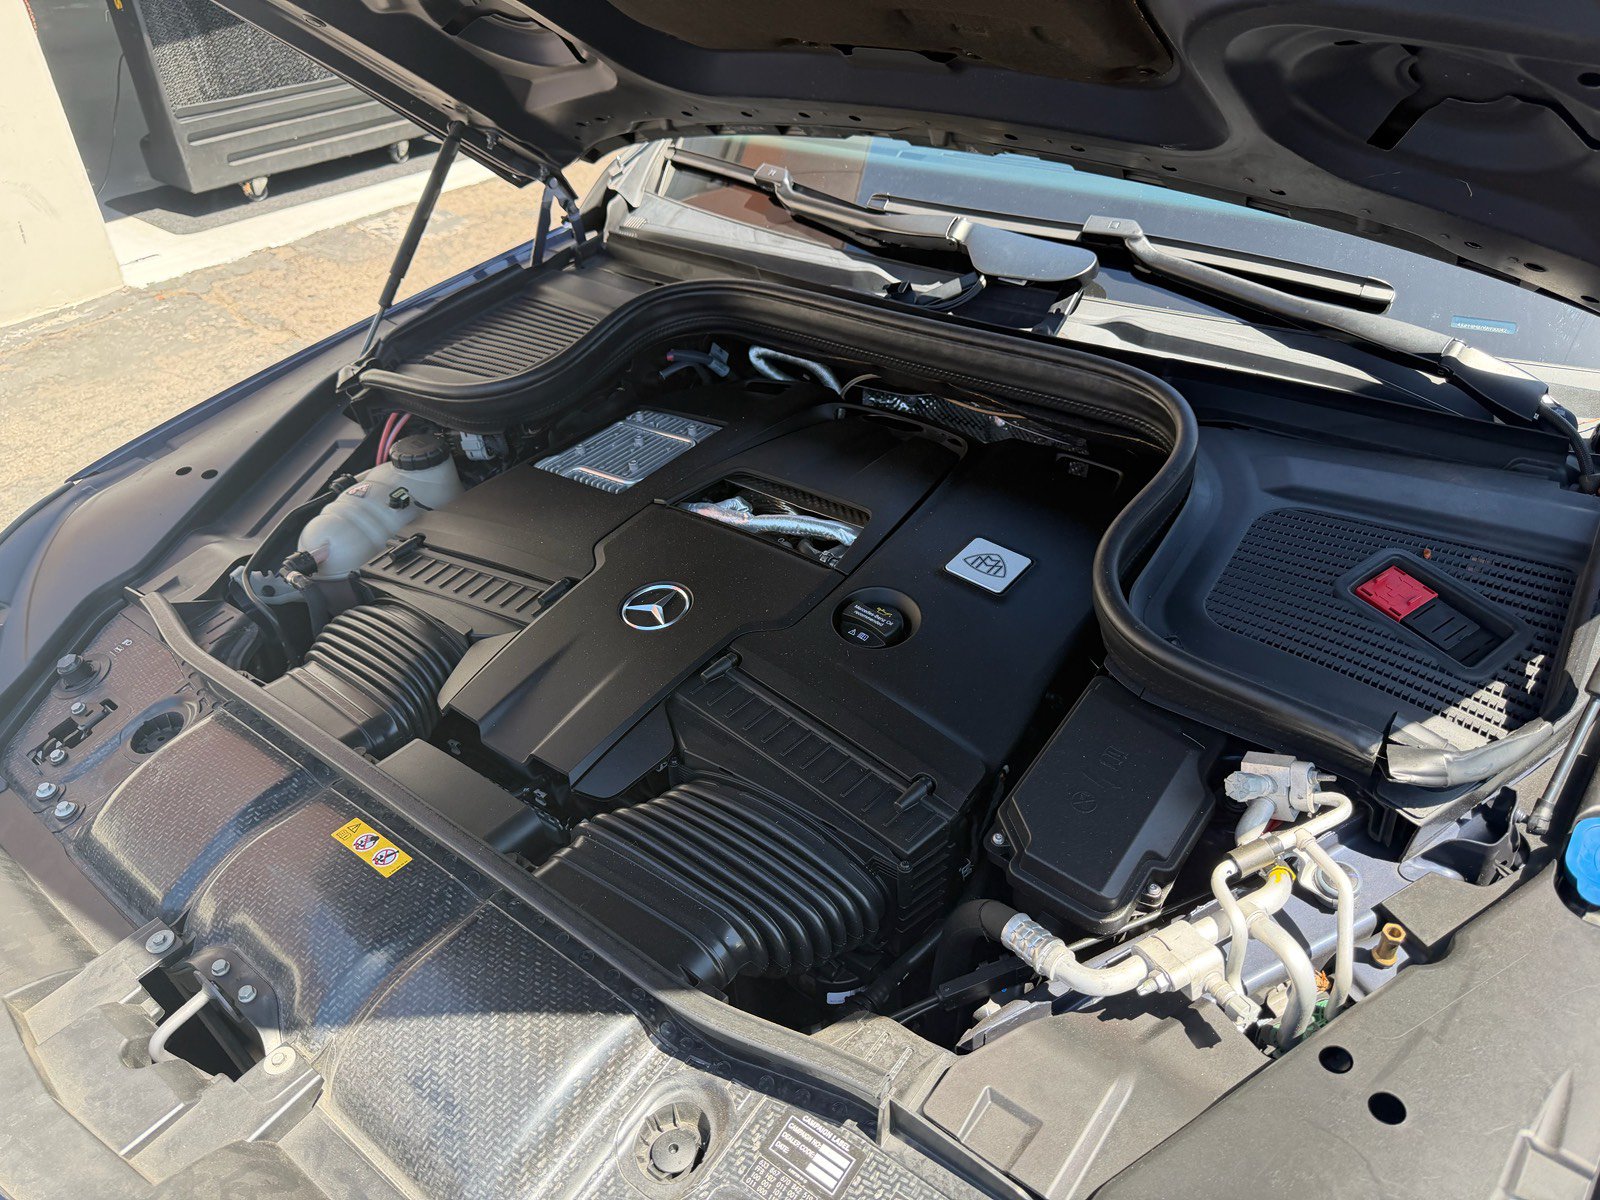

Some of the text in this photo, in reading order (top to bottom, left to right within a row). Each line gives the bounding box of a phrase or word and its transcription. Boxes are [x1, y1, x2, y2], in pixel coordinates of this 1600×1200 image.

[853, 610, 884, 627] recommended
[854, 604, 886, 622] Mercedes-Benz
[774, 1141, 790, 1154] DATE:
[781, 1131, 801, 1148] DEALER
[831, 1134, 851, 1152] LABEL
